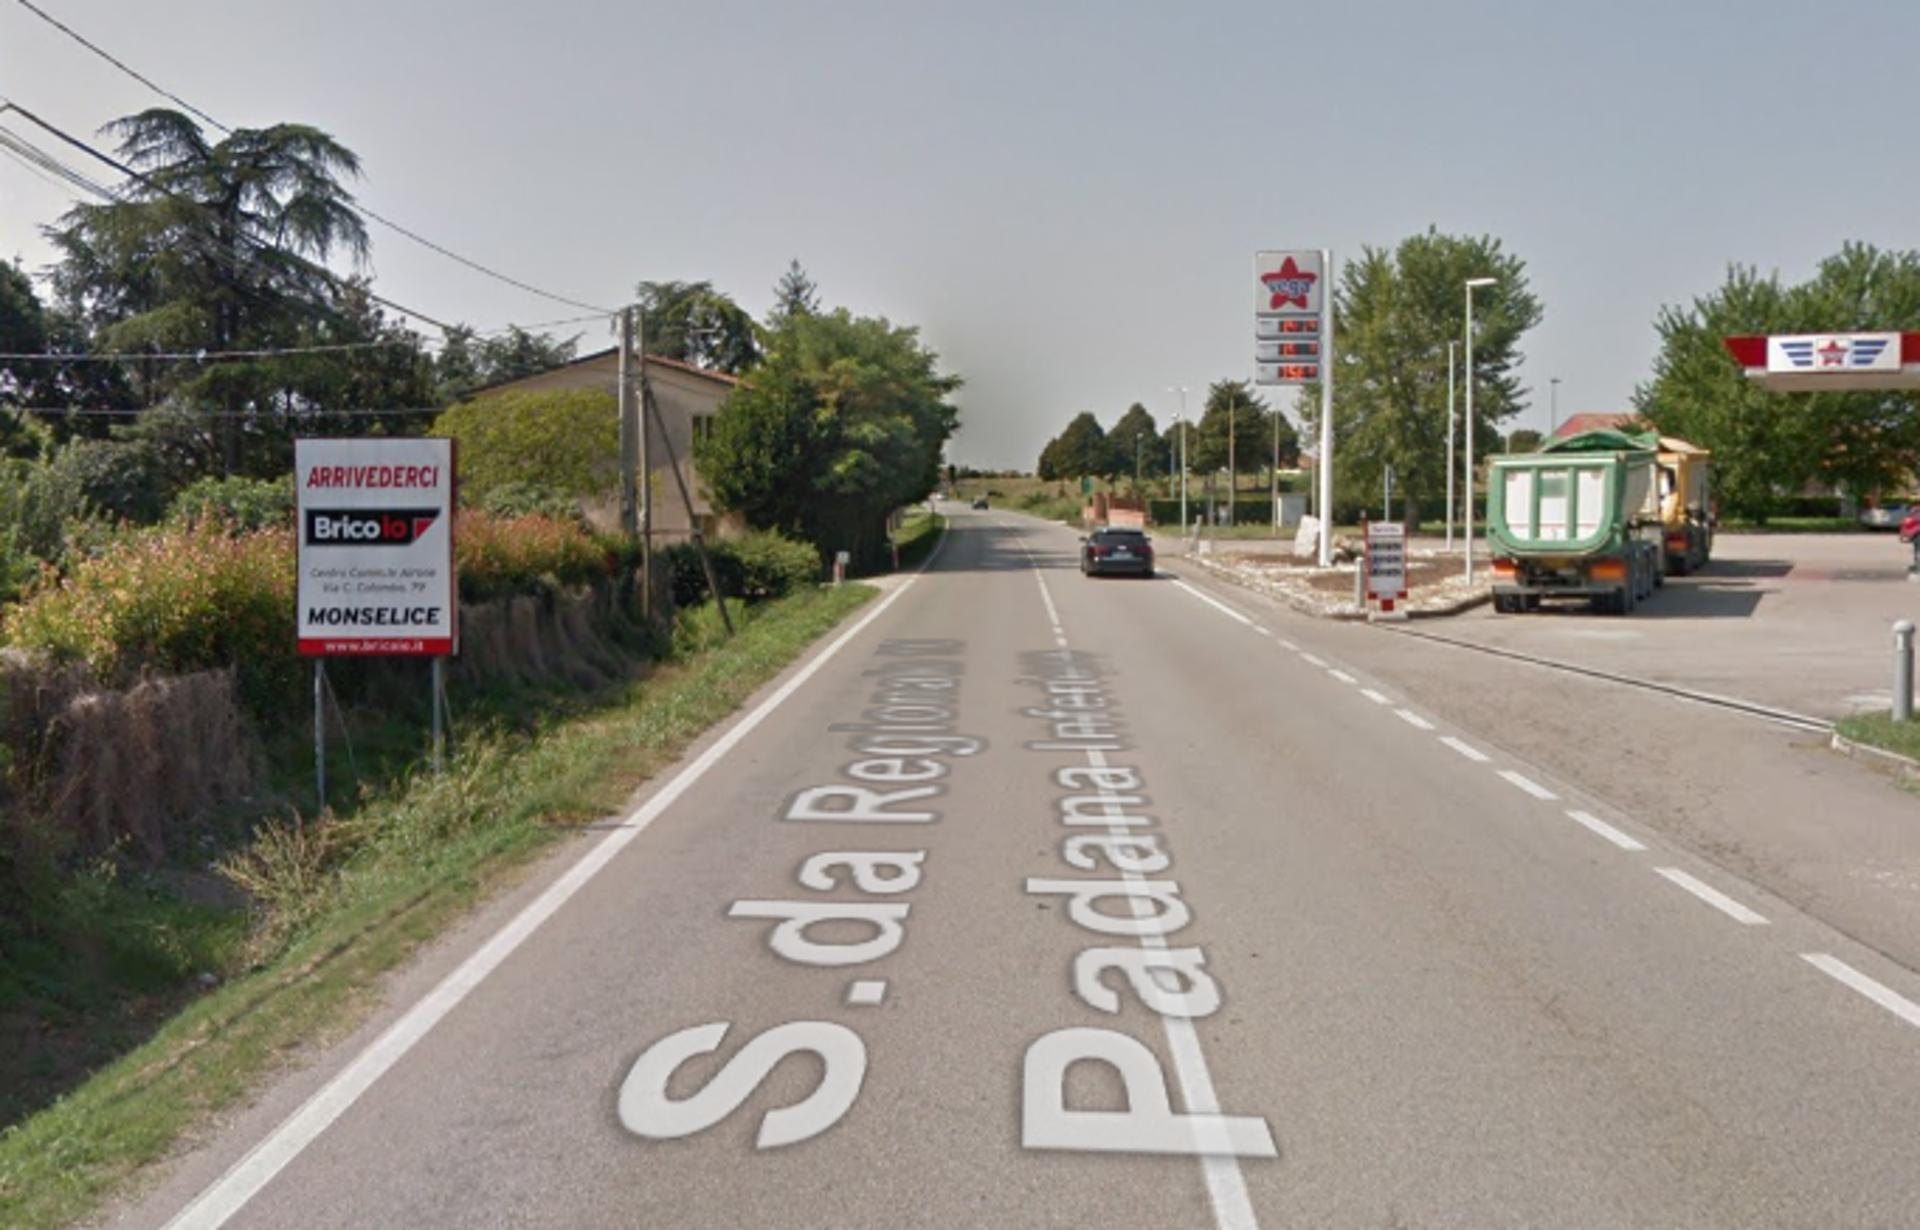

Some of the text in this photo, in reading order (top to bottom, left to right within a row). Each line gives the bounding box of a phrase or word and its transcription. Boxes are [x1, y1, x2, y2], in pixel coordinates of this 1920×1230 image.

[306, 466, 438, 489] ARRIVEDERCI
[309, 567, 346, 578] Centro
[323, 582, 339, 593] Via
[307, 607, 441, 625] MONSELICE
